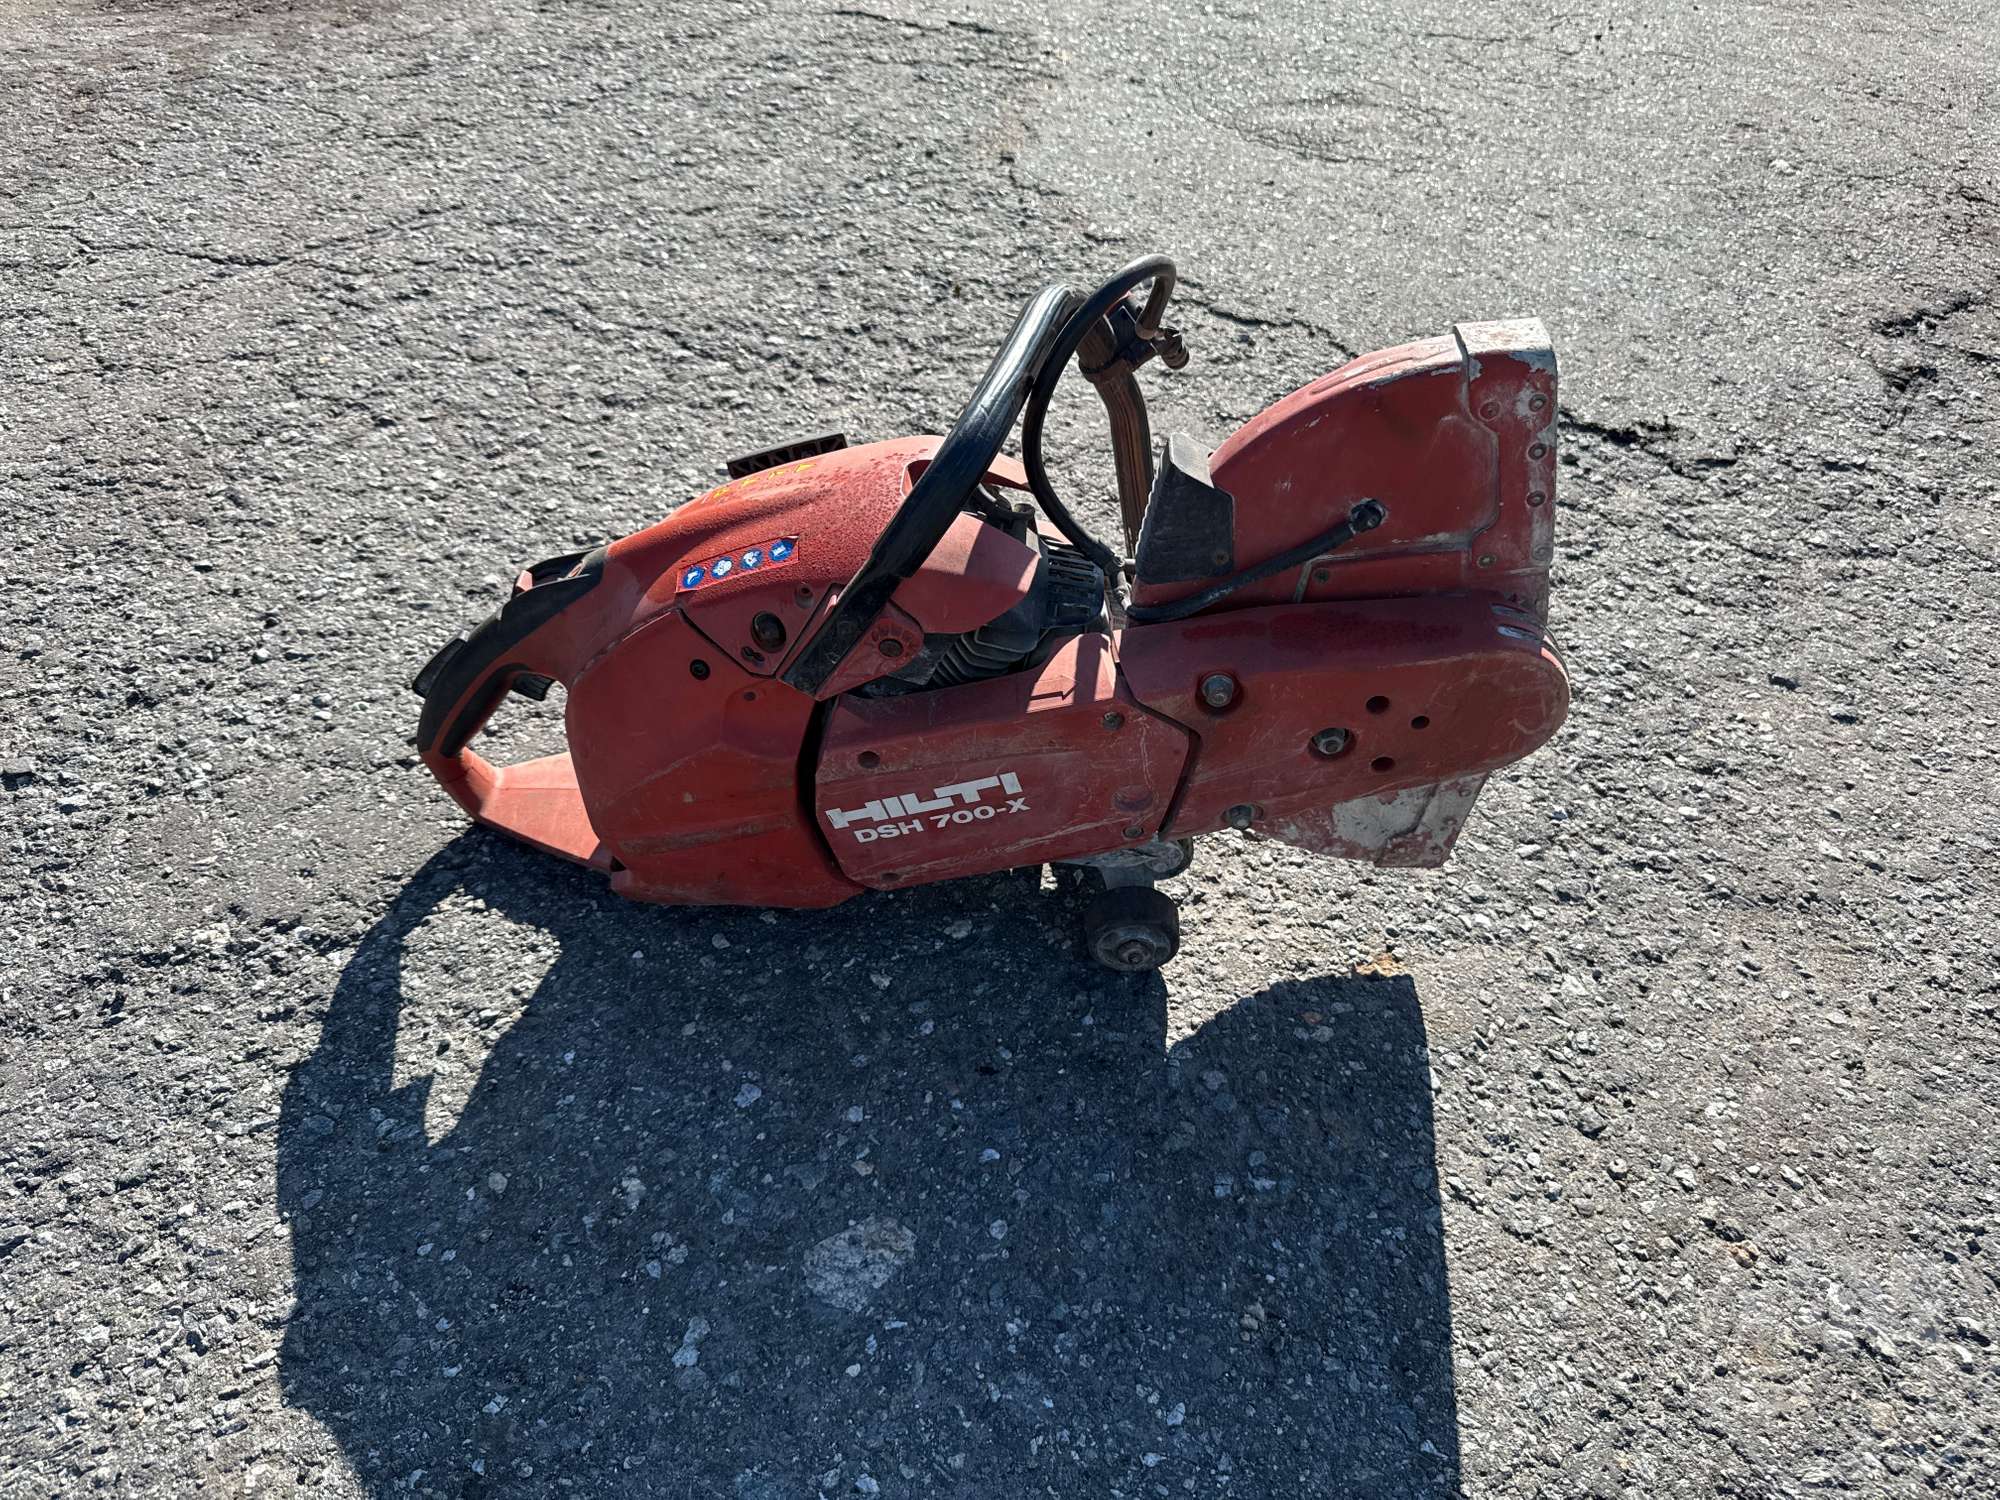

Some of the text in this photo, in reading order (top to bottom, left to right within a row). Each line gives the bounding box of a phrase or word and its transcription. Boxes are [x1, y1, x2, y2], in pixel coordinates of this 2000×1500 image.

[825, 772, 1023, 829] HILTI
[853, 797, 1031, 843] DSH 700-X
